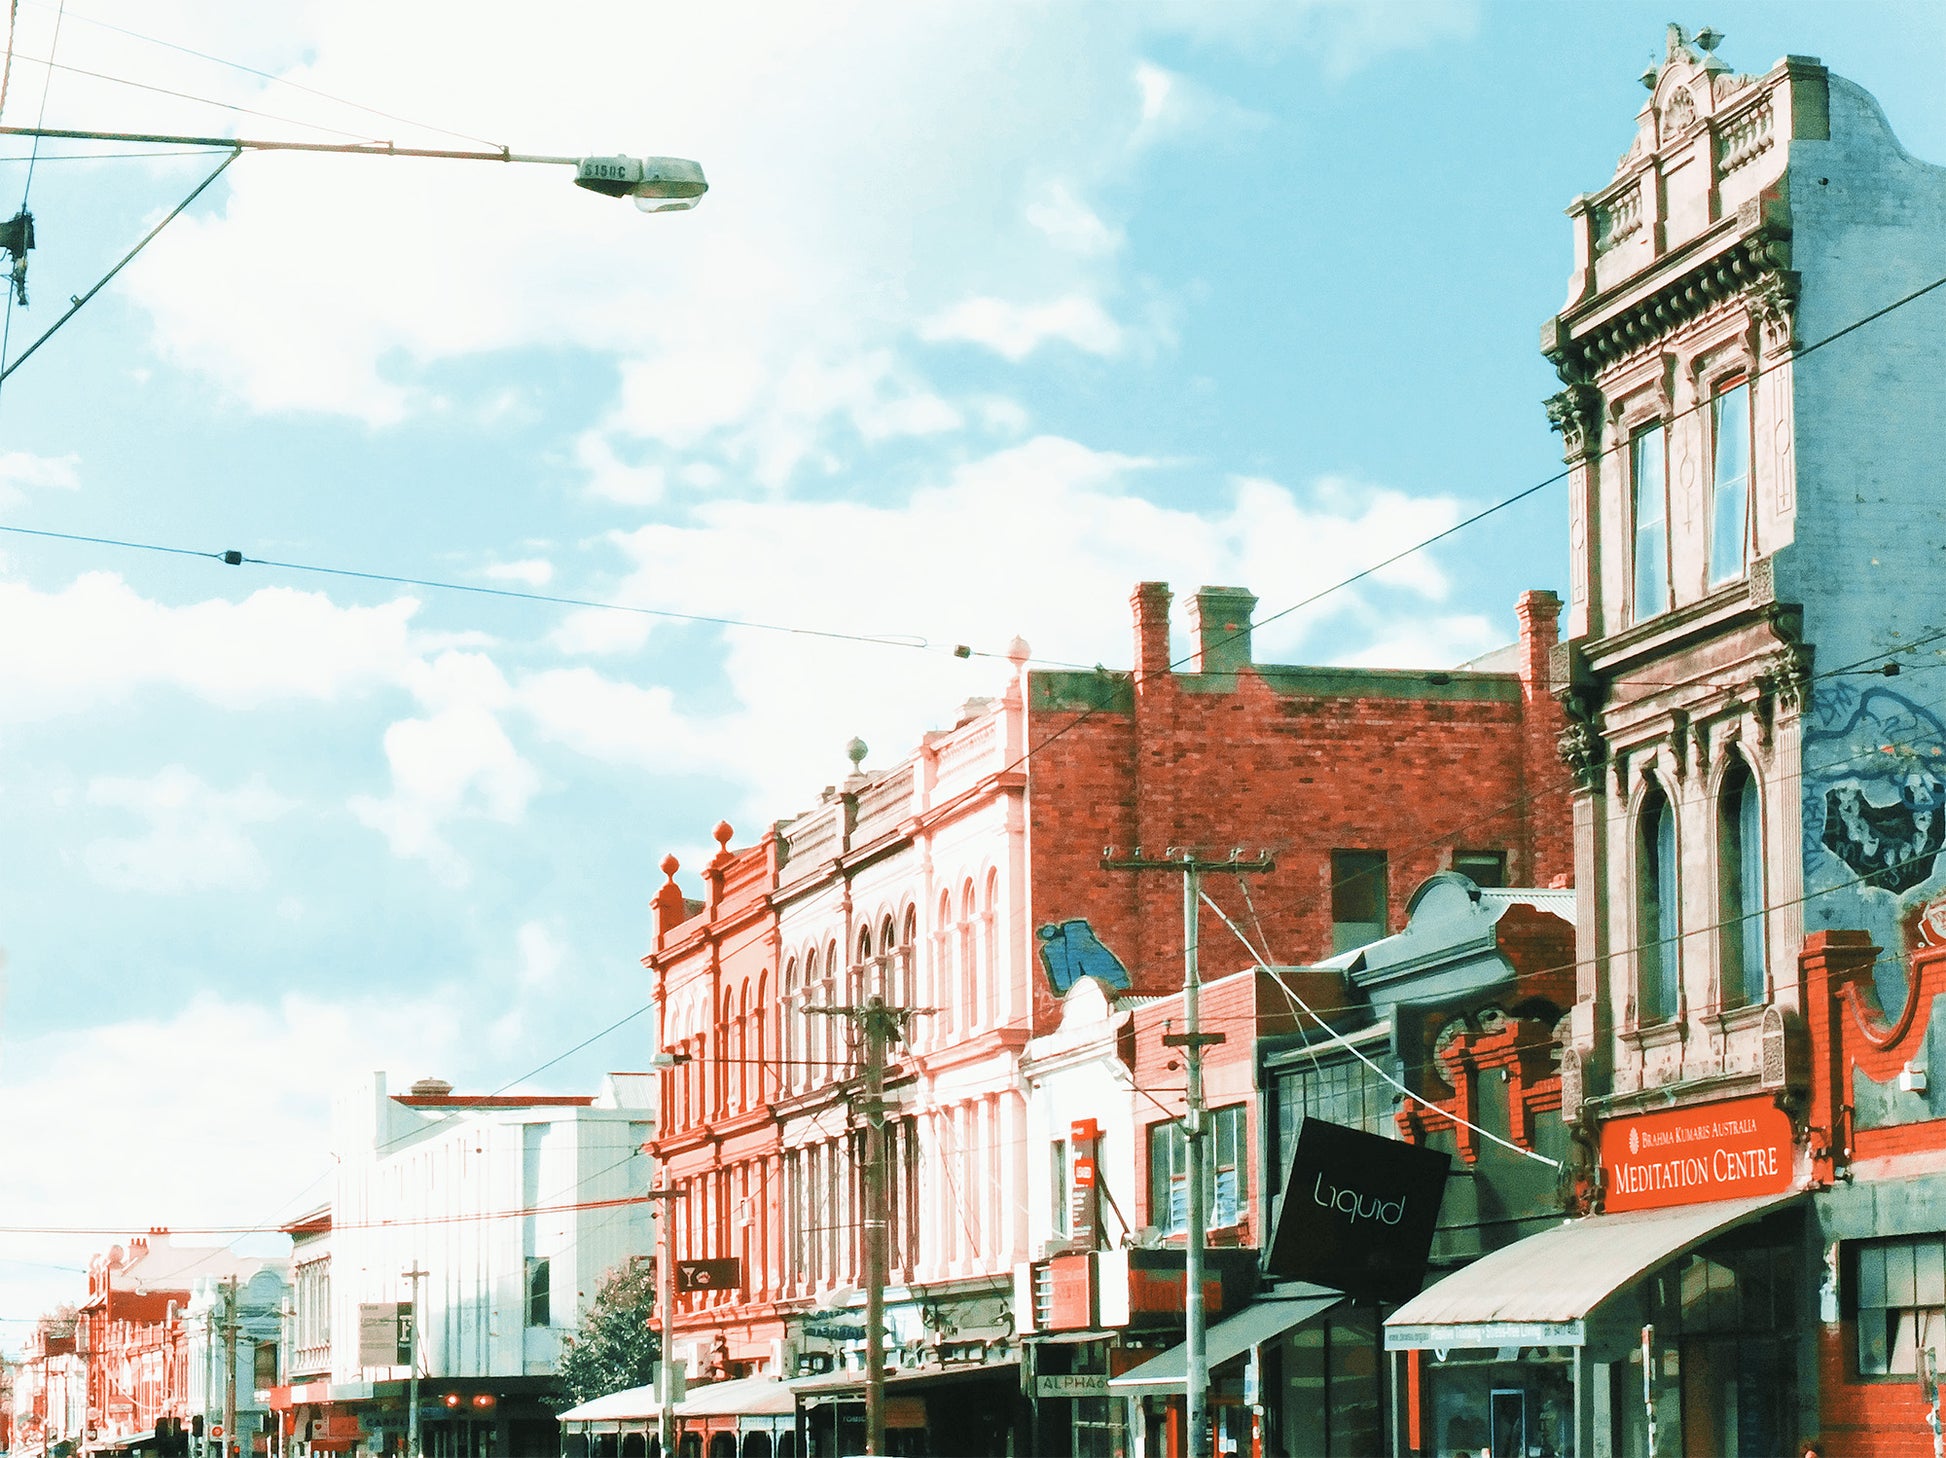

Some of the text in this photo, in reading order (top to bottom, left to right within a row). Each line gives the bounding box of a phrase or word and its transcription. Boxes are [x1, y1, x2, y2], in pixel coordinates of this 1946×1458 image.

[1642, 1119, 1758, 1148] BRAHMA KUMARIS AUSTRALIA
[1614, 1147, 1779, 1195] MEDITATION CENTRE
[1314, 1171, 1406, 1225] Liquid
